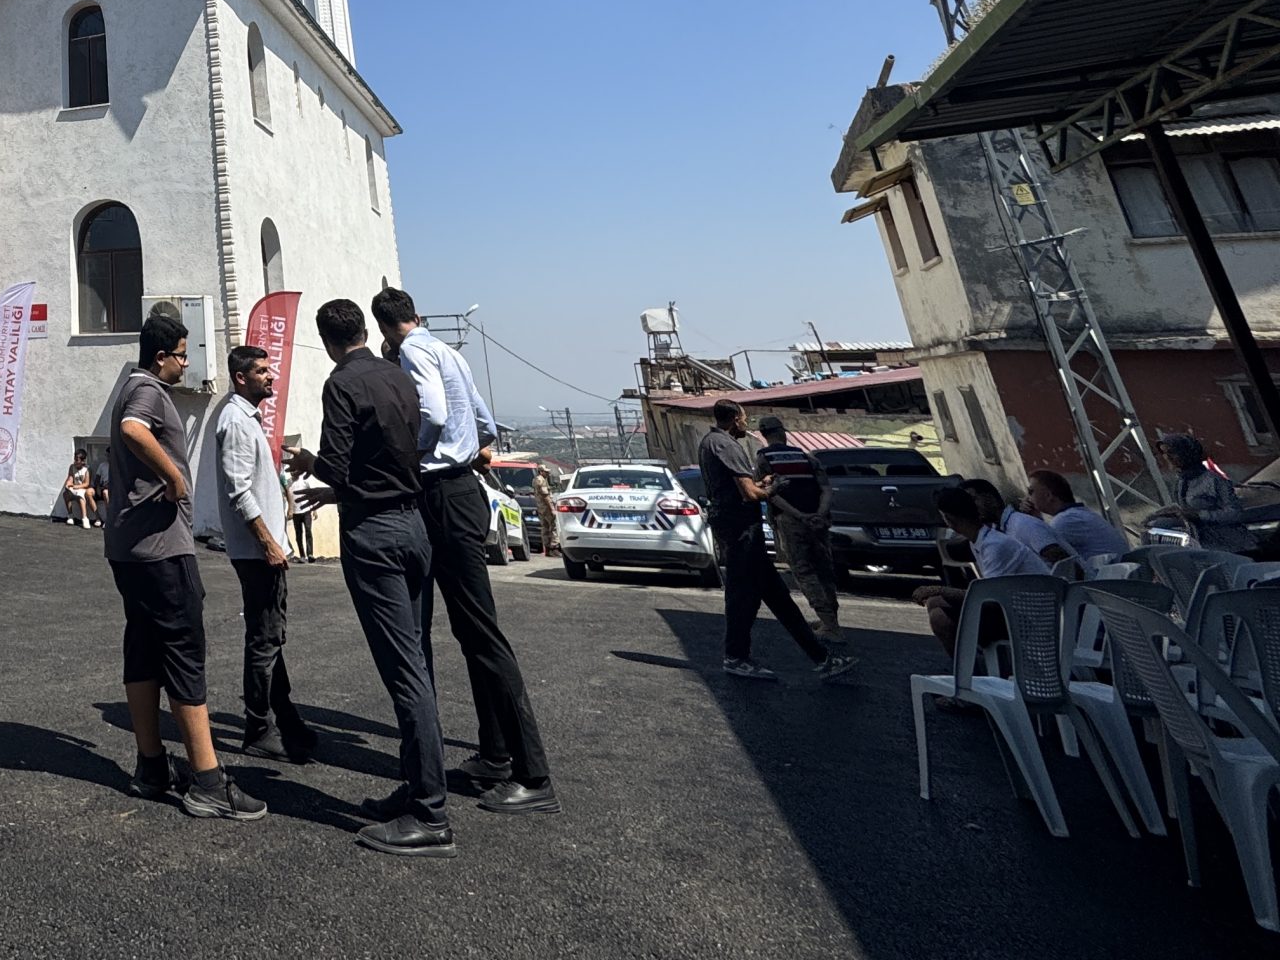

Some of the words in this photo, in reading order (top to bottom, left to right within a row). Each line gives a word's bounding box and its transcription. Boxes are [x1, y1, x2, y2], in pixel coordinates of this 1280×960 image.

[8, 306, 24, 364] VALİLİĞİ
[258, 314, 269, 349] RİYETİ
[3, 369, 16, 415] HATAY
